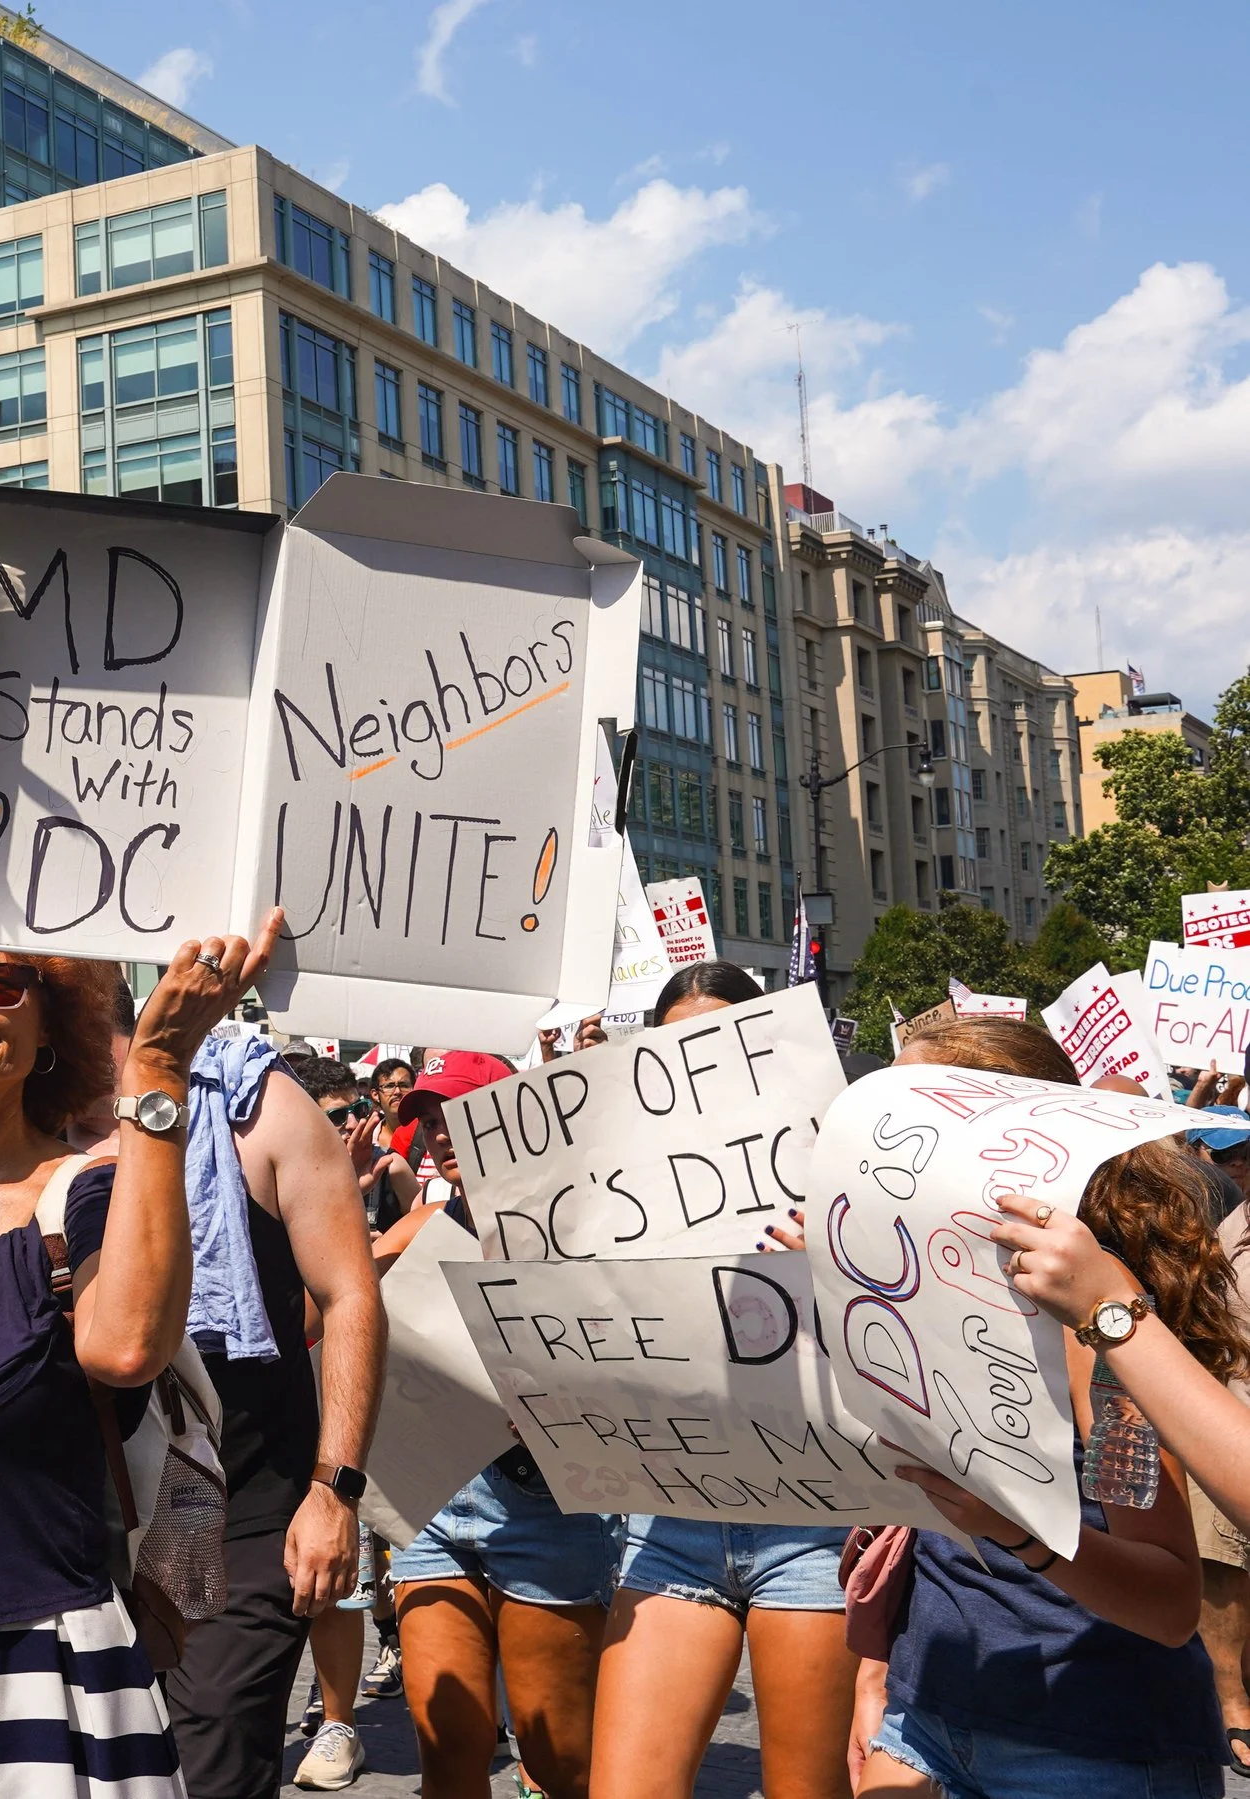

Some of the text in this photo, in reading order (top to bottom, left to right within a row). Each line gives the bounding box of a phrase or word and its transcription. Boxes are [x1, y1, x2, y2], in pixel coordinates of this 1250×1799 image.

[274, 620, 575, 782] Neighbors
[72, 755, 178, 809] With
[26, 816, 181, 934] DC
[274, 800, 558, 946] UNITE!
[661, 914, 702, 937] HAVE
[662, 902, 690, 919] WE
[666, 943, 705, 953] FREEDOM
[675, 952, 706, 962] SAFETY
[1208, 934, 1236, 949] DC
[1149, 959, 1199, 993] Due
[1063, 992, 1120, 1054] TENEMOS
[1075, 1014, 1130, 1074] DERECHO
[1155, 1002, 1207, 1045] For
[461, 1009, 775, 1178] HOP OFF
[494, 1117, 821, 1261] DC'S DIC
[476, 1279, 691, 1363] FREE
[712, 1265, 831, 1366] D
[827, 1193, 932, 1419] DC
[932, 1314, 1055, 1484] Your
[516, 1393, 887, 1480] FREE MY
[640, 1462, 870, 1513] HOME
